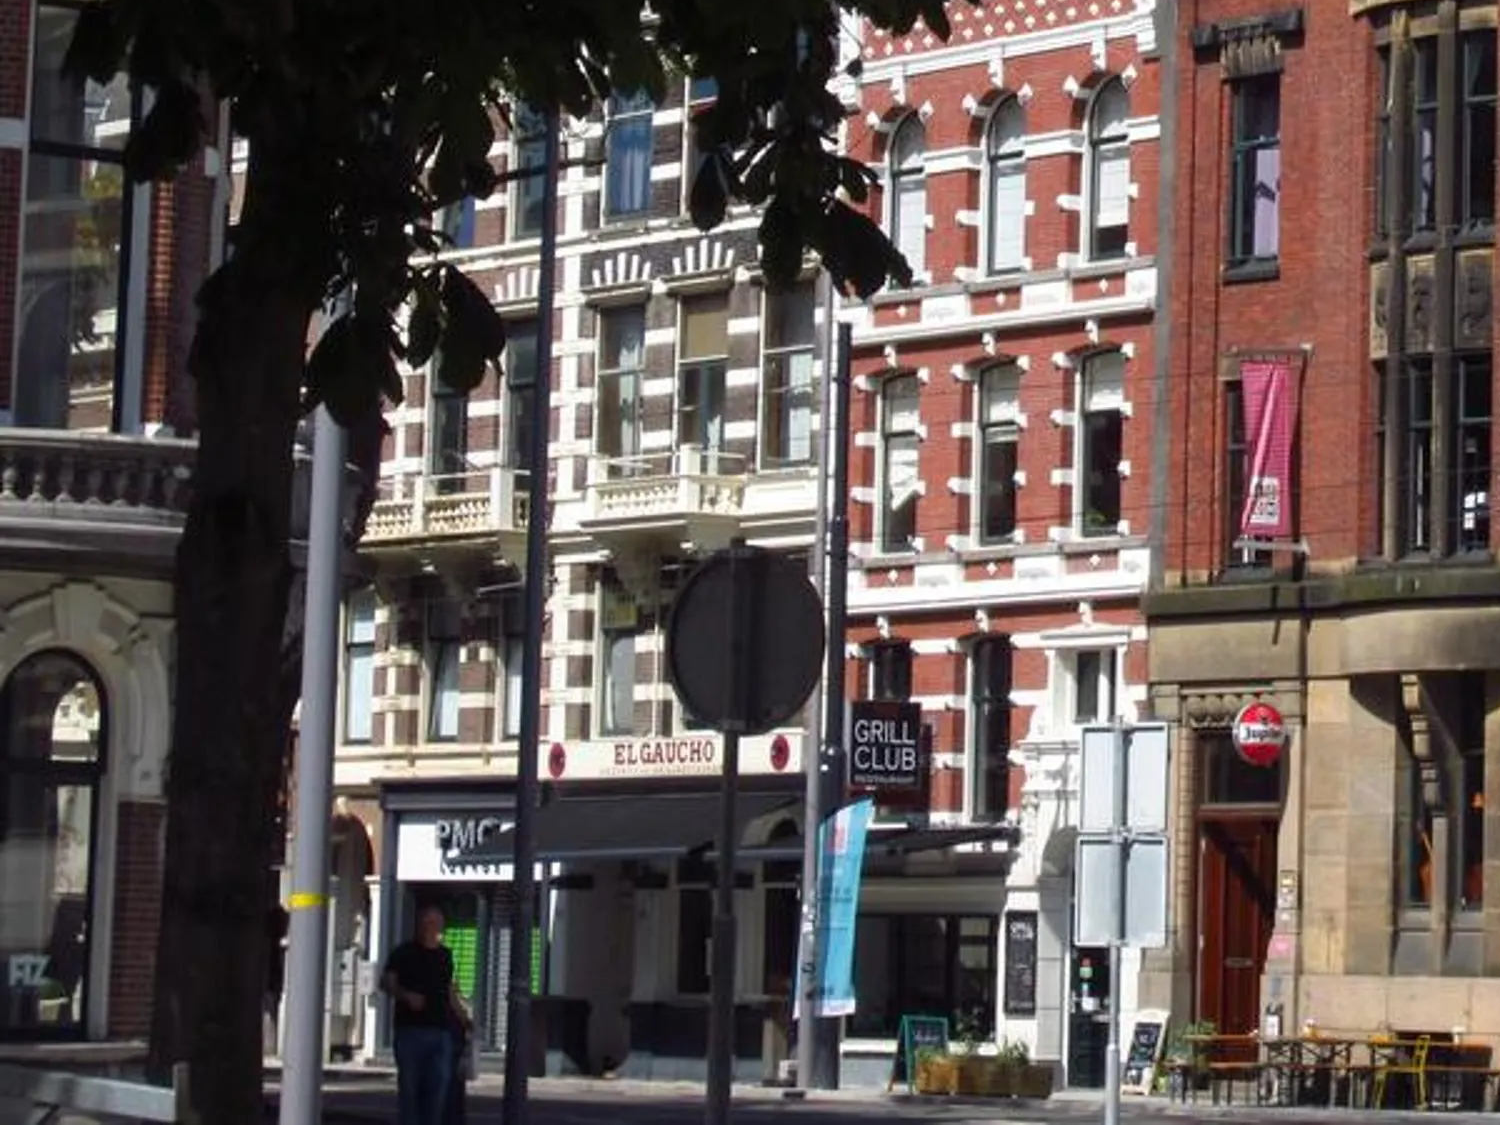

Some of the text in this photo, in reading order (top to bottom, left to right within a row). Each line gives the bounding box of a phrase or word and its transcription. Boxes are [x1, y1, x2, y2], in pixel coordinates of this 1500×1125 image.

[854, 719, 916, 745] GRILL
[640, 740, 715, 764] GAUCHO
[854, 745, 916, 771] CLUB
